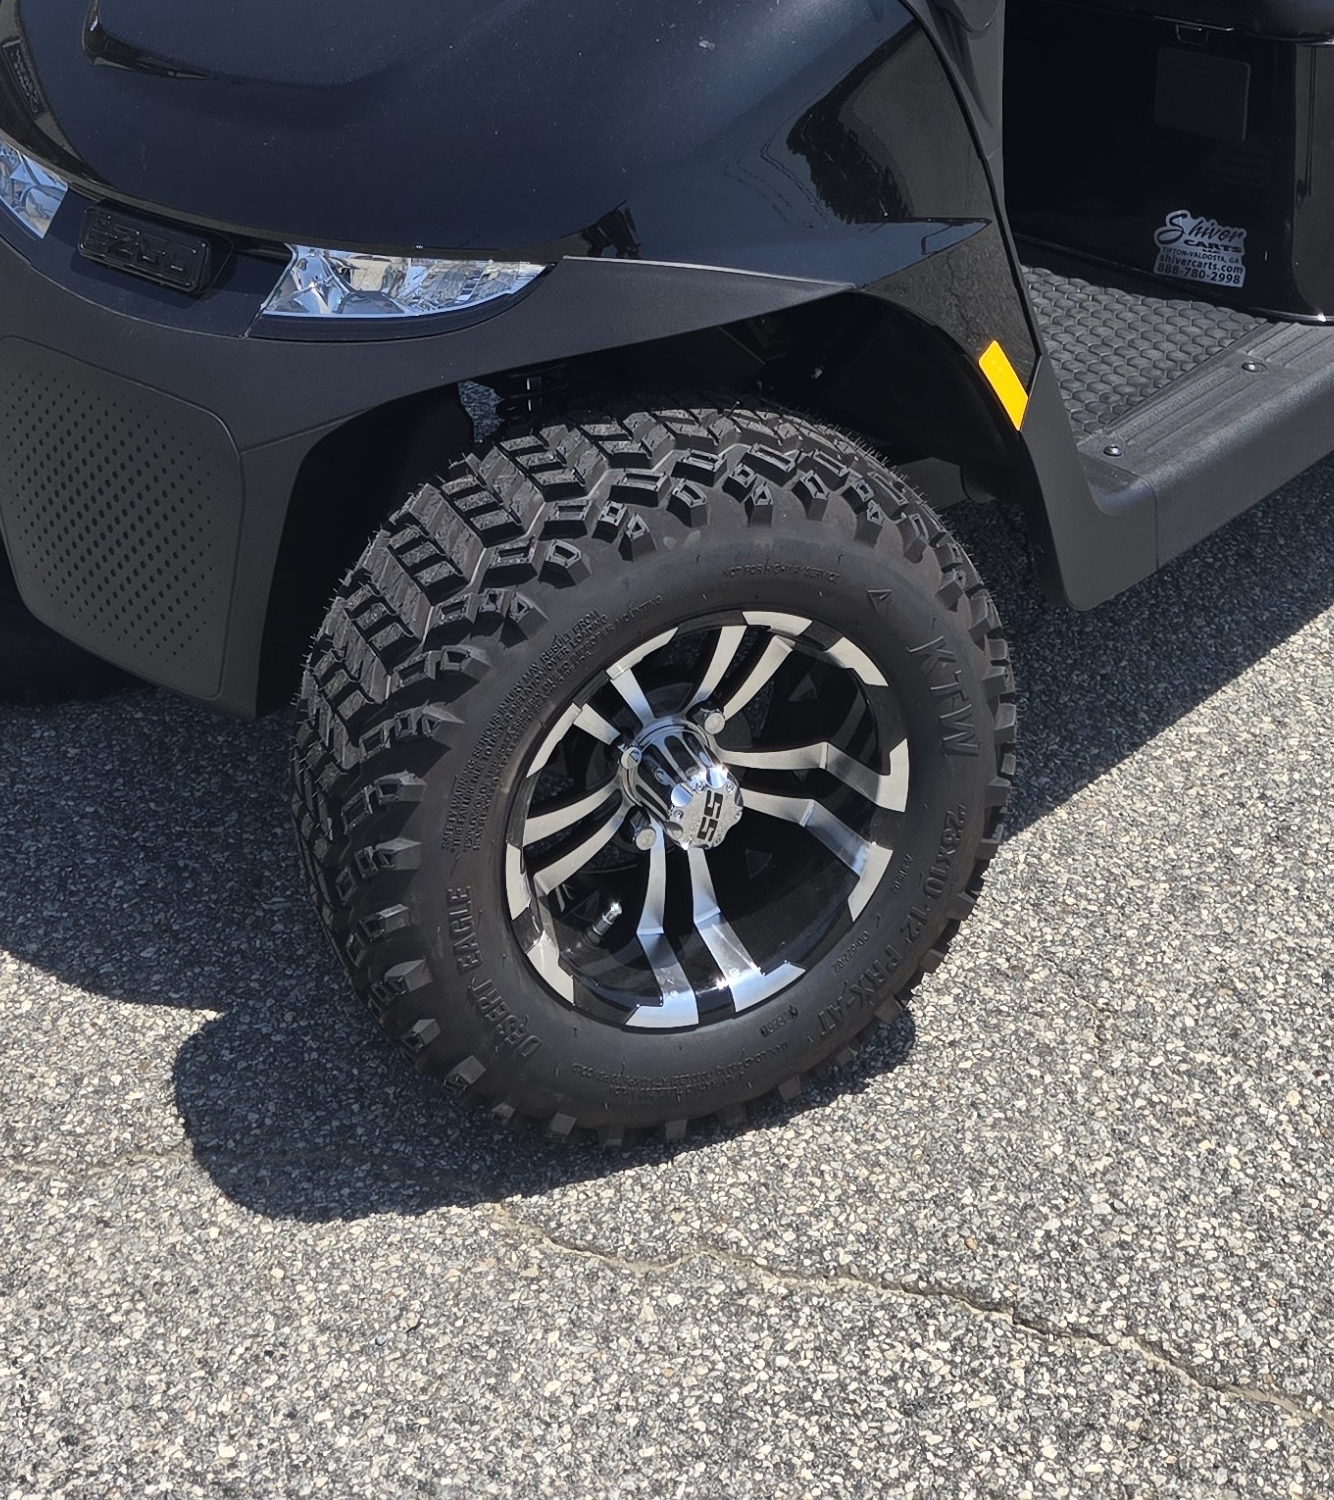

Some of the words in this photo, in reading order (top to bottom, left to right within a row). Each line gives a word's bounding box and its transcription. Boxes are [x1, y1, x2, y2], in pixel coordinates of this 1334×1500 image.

[1157, 213, 1244, 245] Shiver
[1183, 239, 1243, 253] CARTS
[1157, 262, 1241, 284] 888-780-2998
[1159, 253, 1244, 274] shivercarts.com
[519, 660, 540, 685] MAY
[537, 627, 574, 664] RESULT
[569, 606, 601, 634] FROM
[567, 612, 610, 649] LOADING
[906, 635, 980, 758] KTW
[446, 885, 483, 974] EAGLE
[471, 978, 543, 1058] DESERT
[817, 944, 904, 1036] PRX-AT
